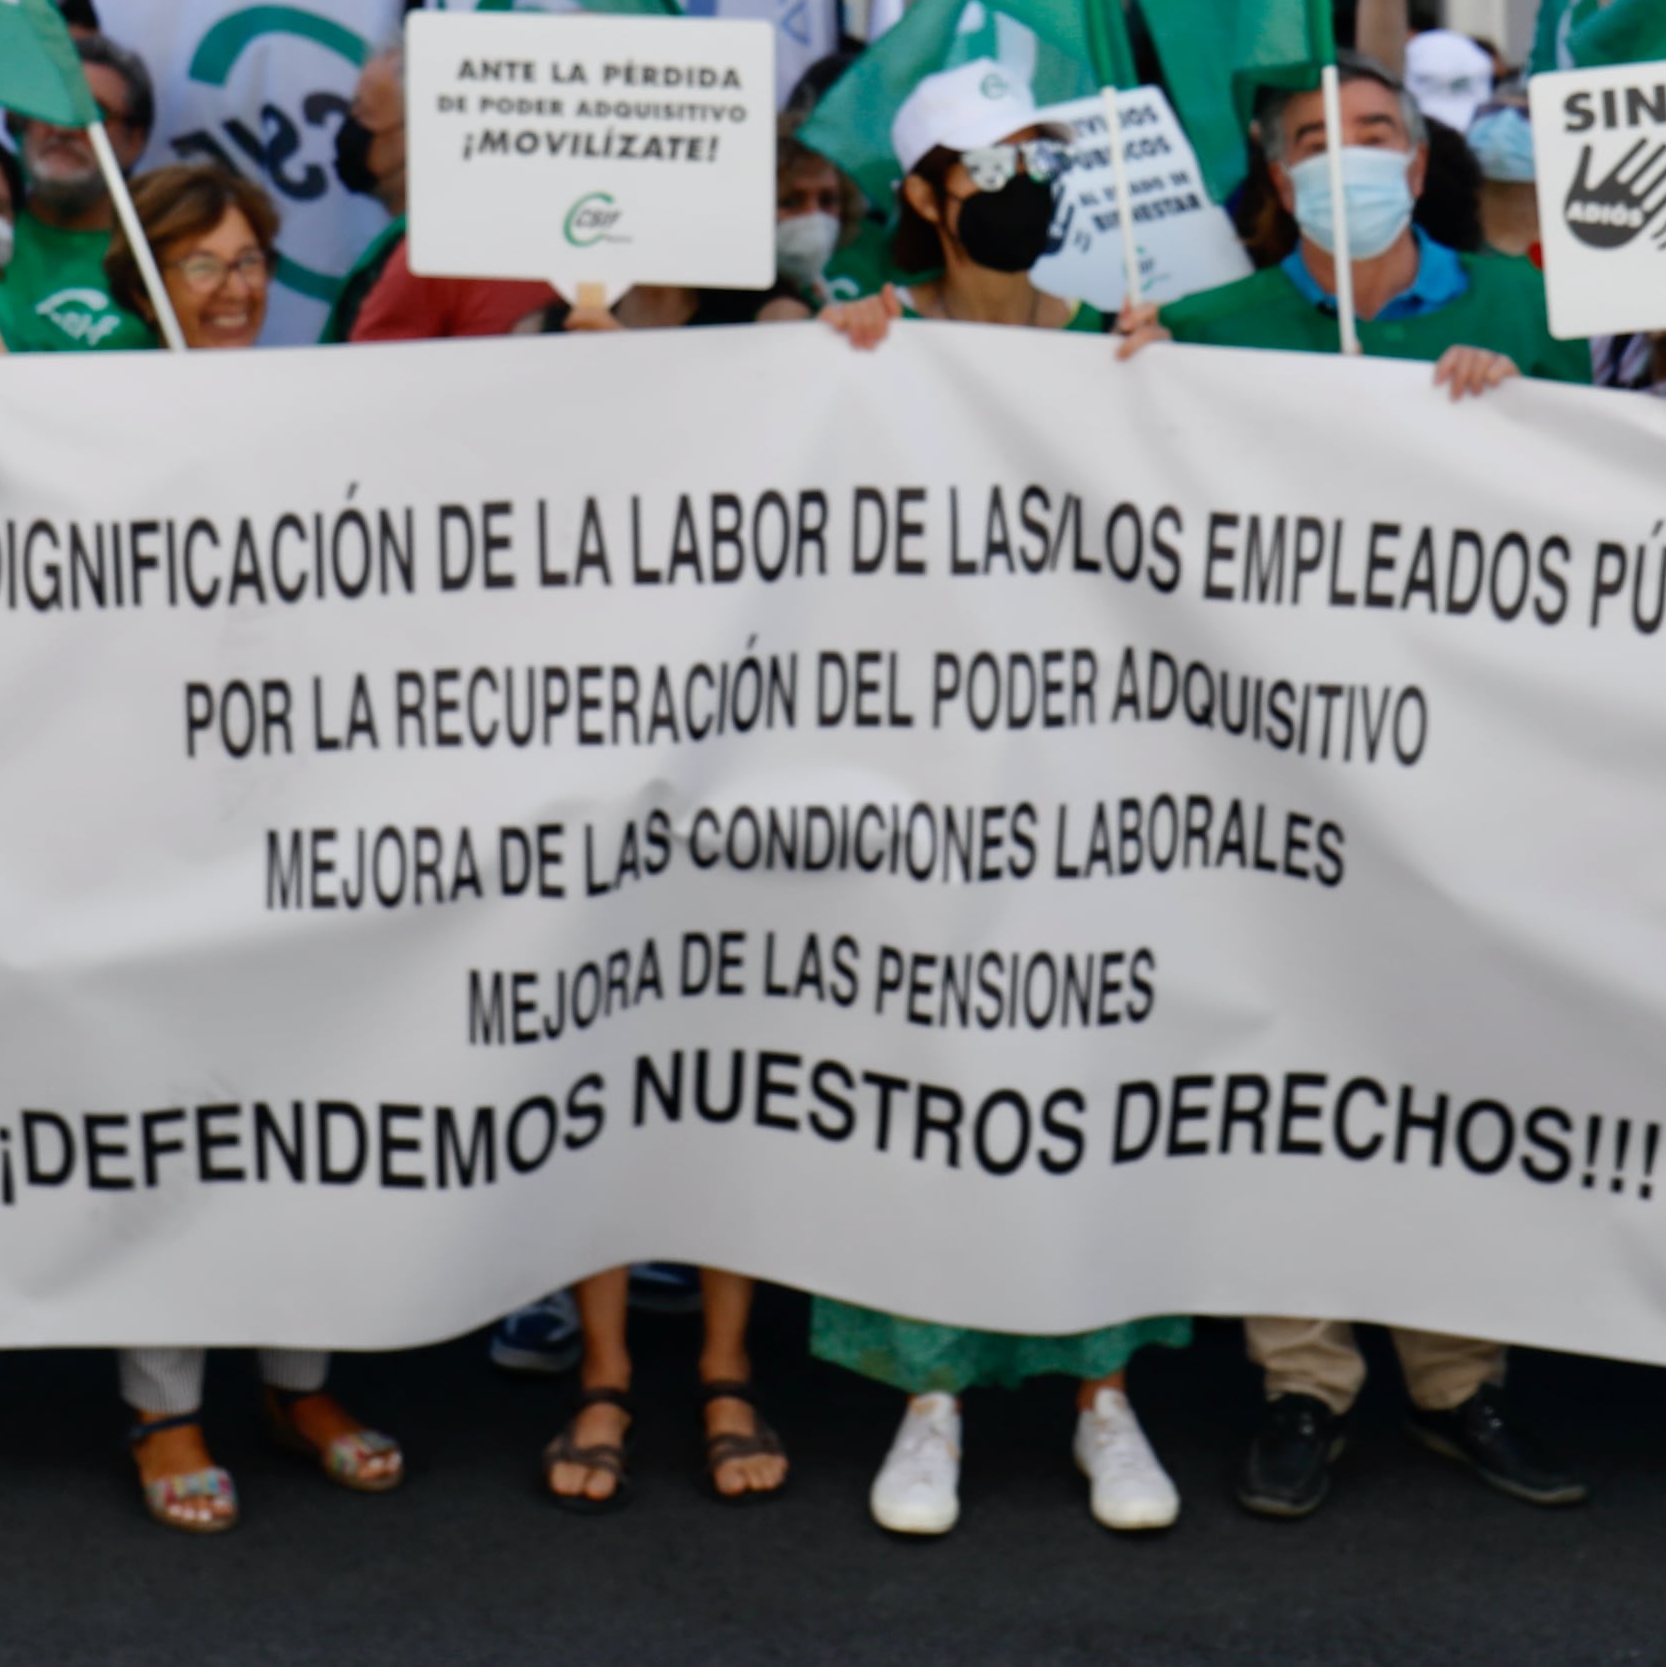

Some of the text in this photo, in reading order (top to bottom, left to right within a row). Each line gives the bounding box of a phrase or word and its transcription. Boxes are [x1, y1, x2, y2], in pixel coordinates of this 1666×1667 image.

[437, 94, 749, 125] DE PODER ADQUISITIVO
[458, 58, 743, 91] ANTE LA PÉRDIDA
[462, 125, 720, 164] ¡MOVILÍZATE!
[1567, 196, 1645, 228] ADIÓS
[437, 500, 517, 593] DE
[536, 496, 613, 589] LA
[630, 488, 830, 587] LABOR
[850, 486, 928, 577] DE
[949, 483, 1184, 596] LAS/LOS
[1202, 511, 1572, 627] EMPLEADOS
[184, 635, 1428, 767] POR LA RECUPERACIÓN DEL PODER ADQUISITIVO
[266, 793, 1346, 911] MEJORA DE LAS CONDICIONES LABORALES
[468, 931, 1156, 1046] MEJORA DE LAS PENSIONES
[632, 1048, 1088, 1178] NUESTROS
[1110, 1072, 1662, 1201] DERECHOS!!!
